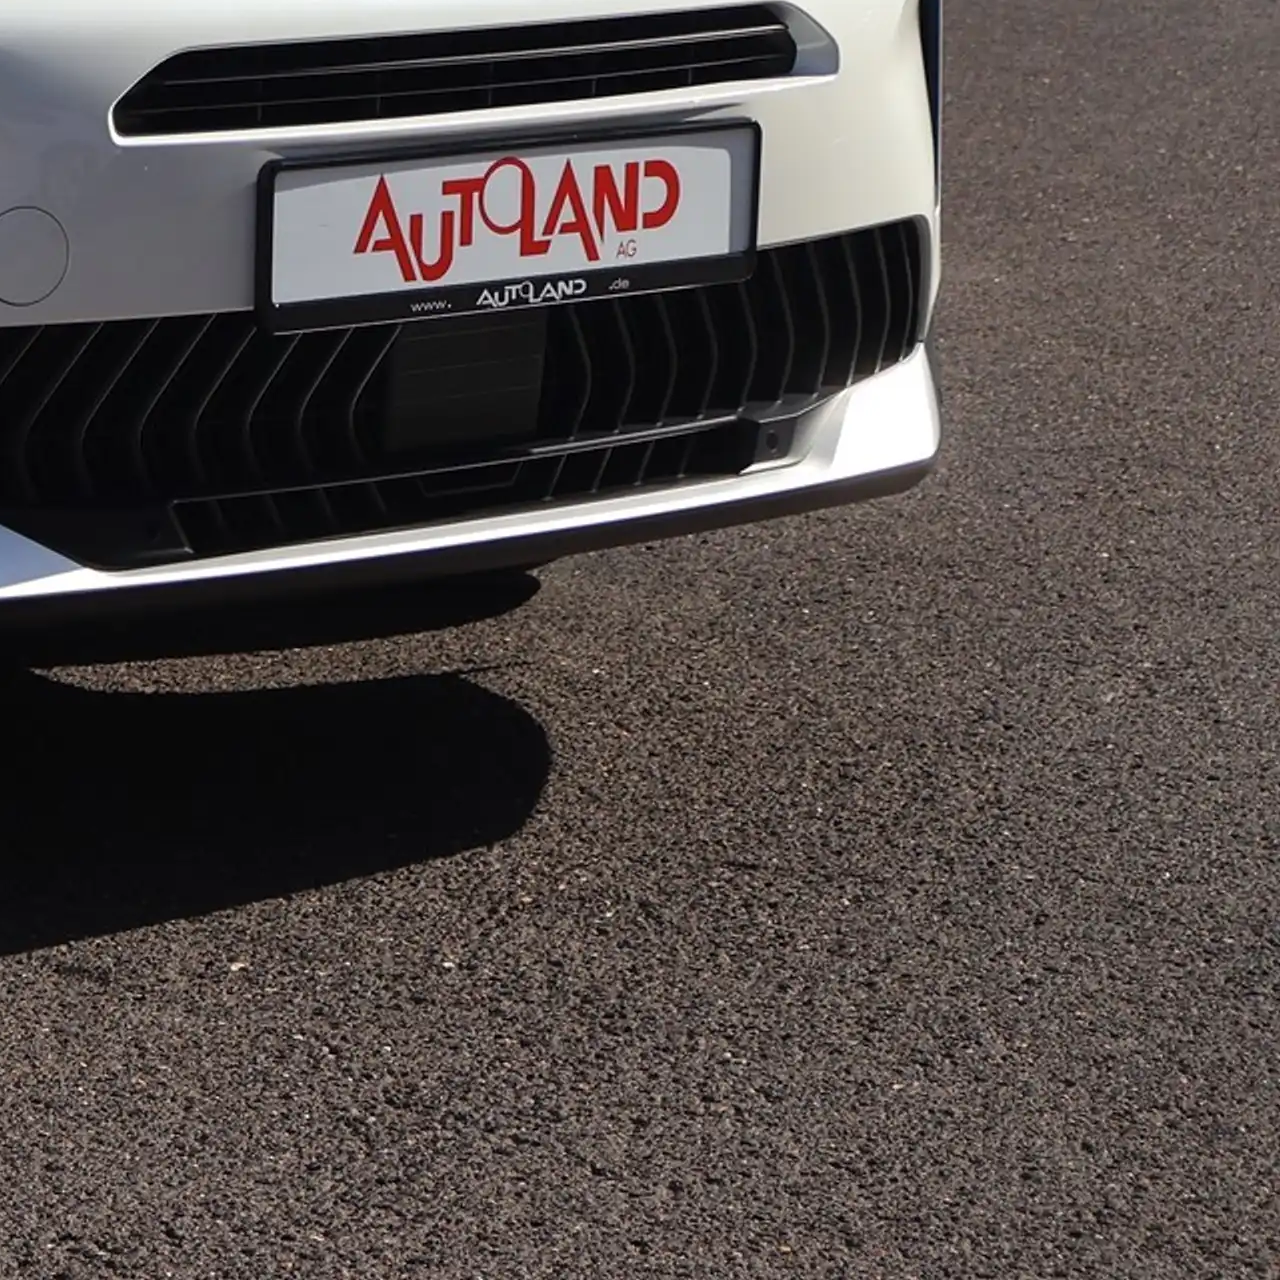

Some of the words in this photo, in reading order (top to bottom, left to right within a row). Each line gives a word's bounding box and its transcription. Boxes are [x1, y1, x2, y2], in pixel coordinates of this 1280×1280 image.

[353, 154, 682, 283] AUTOLAND
[616, 239, 638, 260] AG
[409, 299, 452, 313] www.
[476, 280, 587, 309] AUTOLAND
[608, 277, 630, 291] .de
